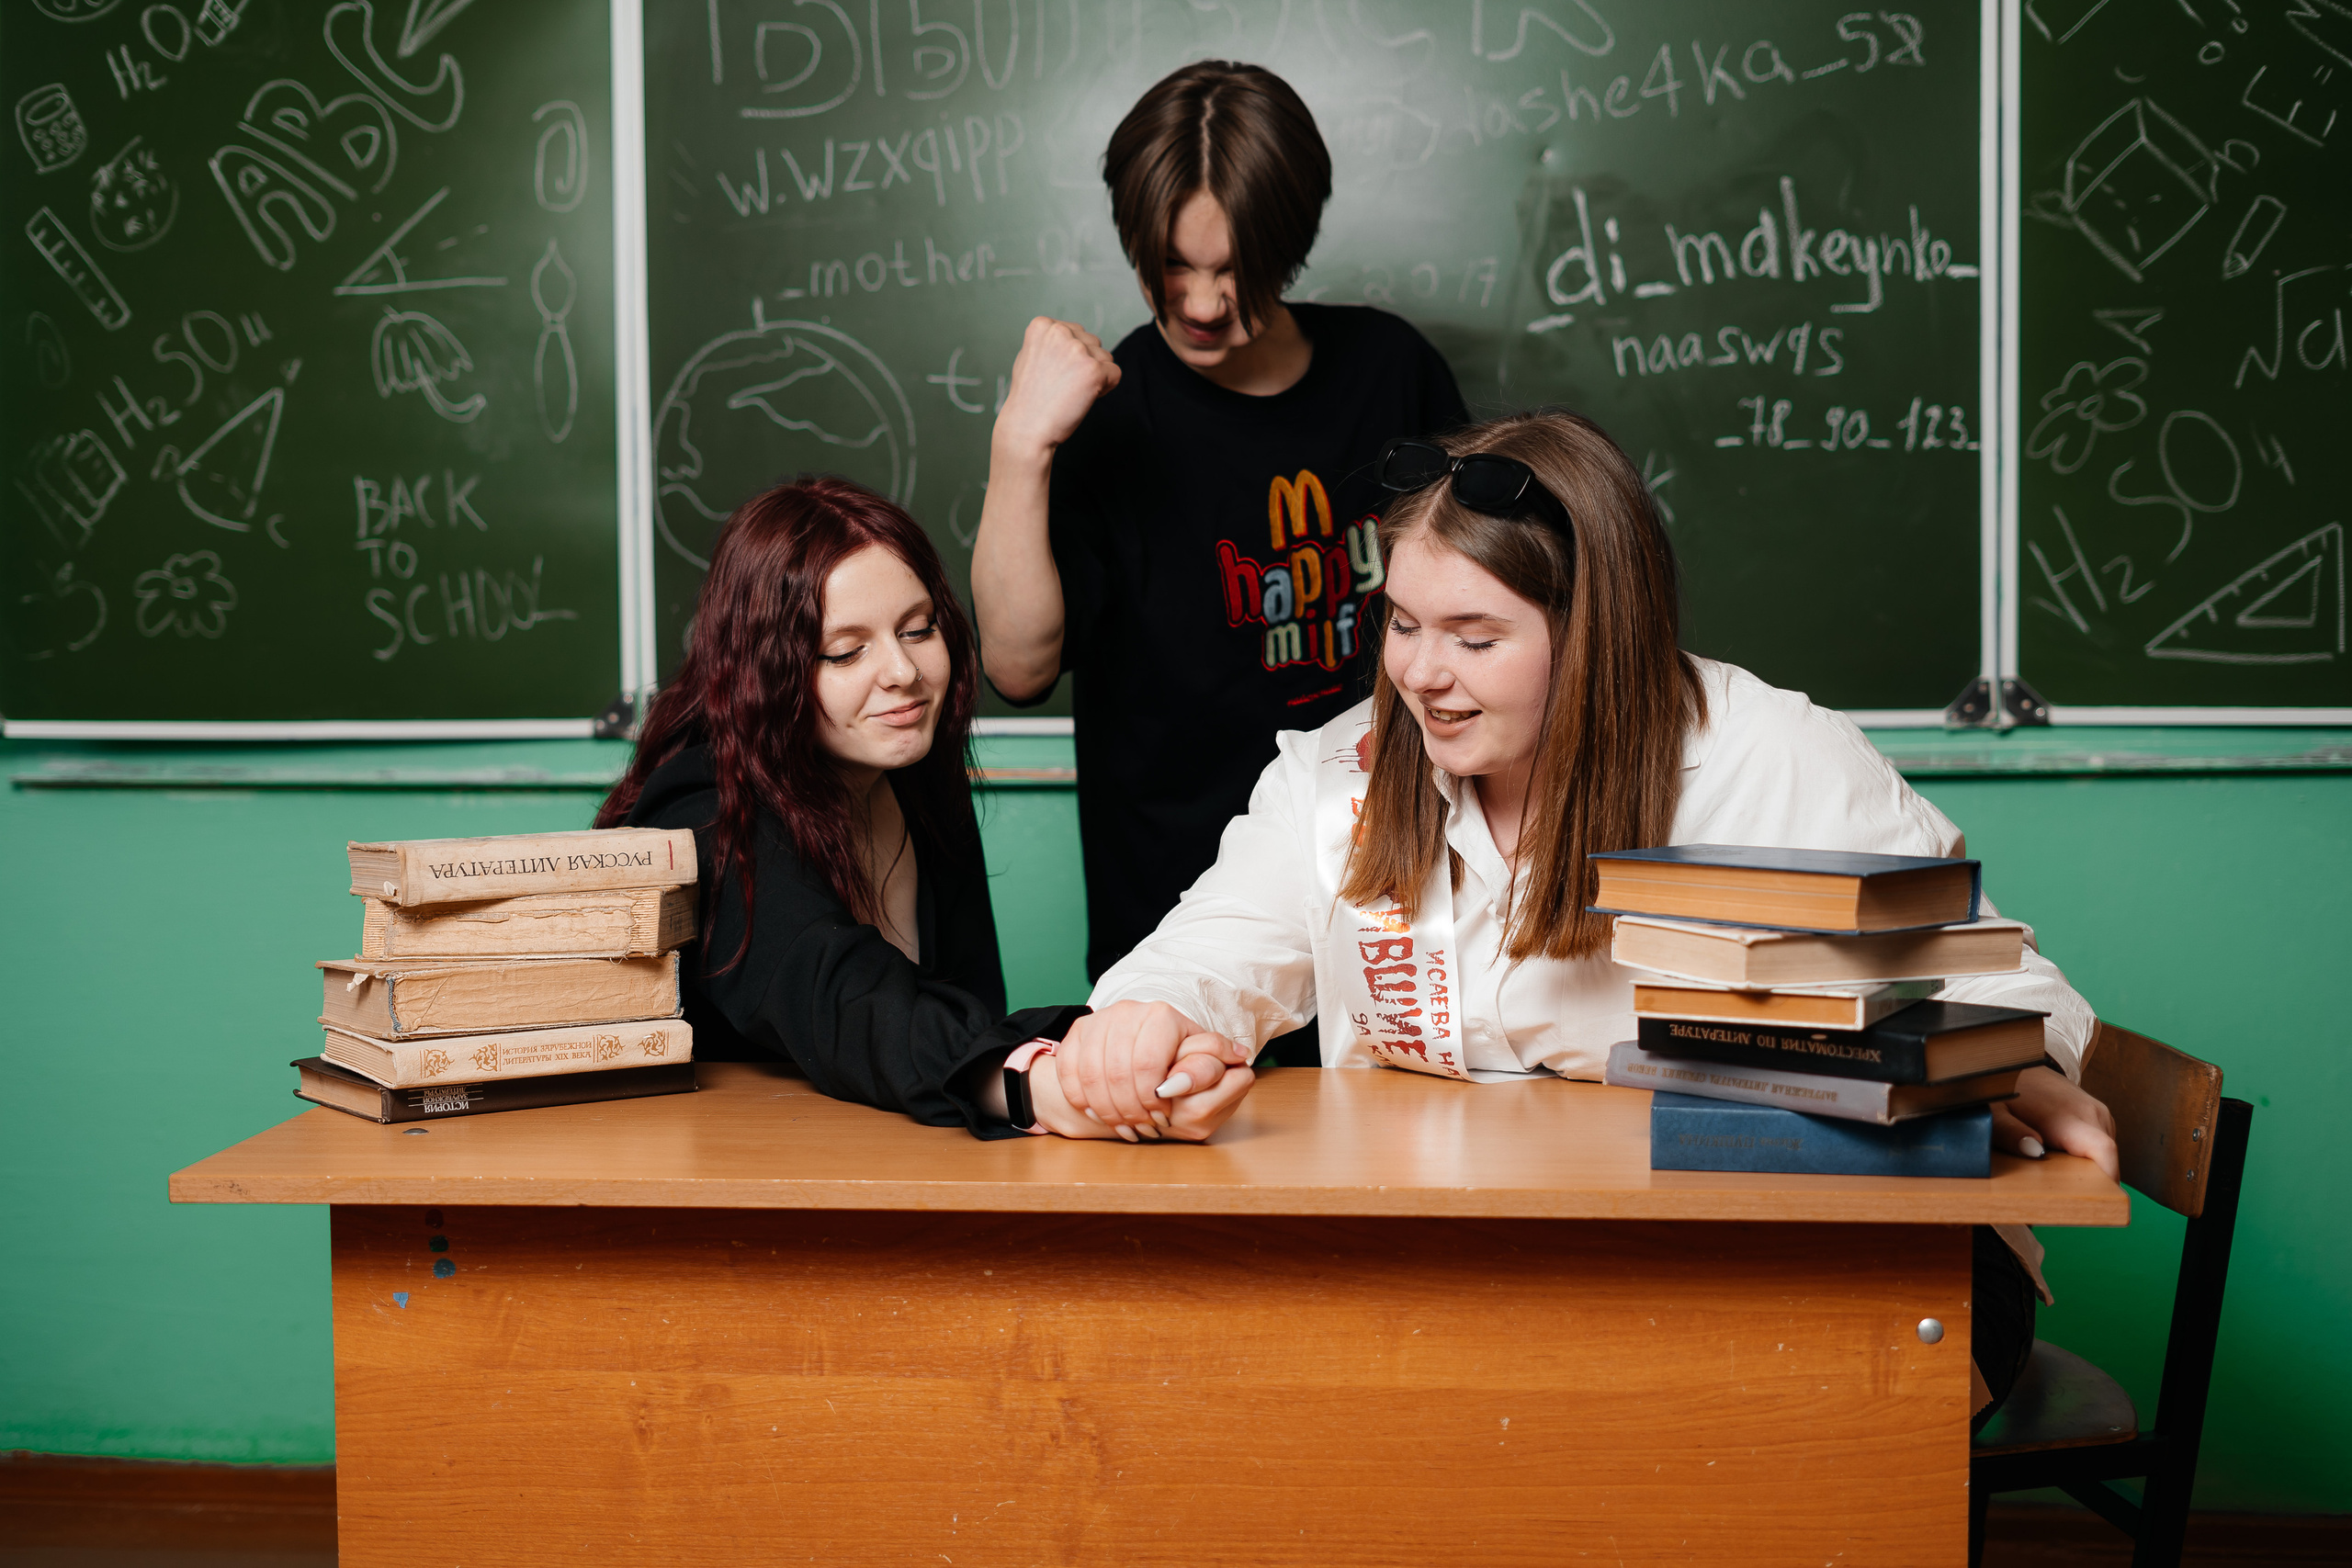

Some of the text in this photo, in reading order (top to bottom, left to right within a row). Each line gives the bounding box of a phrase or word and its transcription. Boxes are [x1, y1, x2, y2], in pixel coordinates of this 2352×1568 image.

[353, 468, 489, 538] BACK
[356, 537, 419, 579] TO
[1264, 603, 1356, 669] milf
[428, 851, 653, 880] РУССКАЯ ЛИТЕРАТУРА
[1426, 948, 1452, 1041] ИСАЕВА
[502, 1040, 593, 1055] ИСТОРИЯ ЗАРУБЕЖНОЙ
[503, 1055, 552, 1066] ЛИТЕРАТУРЫ
[571, 1051, 593, 1059] ВЕКА
[1668, 1023, 1883, 1064] ХРЕСТОМАТИЯ ПО ЛИТЕРАТУРЕ
[424, 1100, 469, 1113] ИСТОРИЯ
